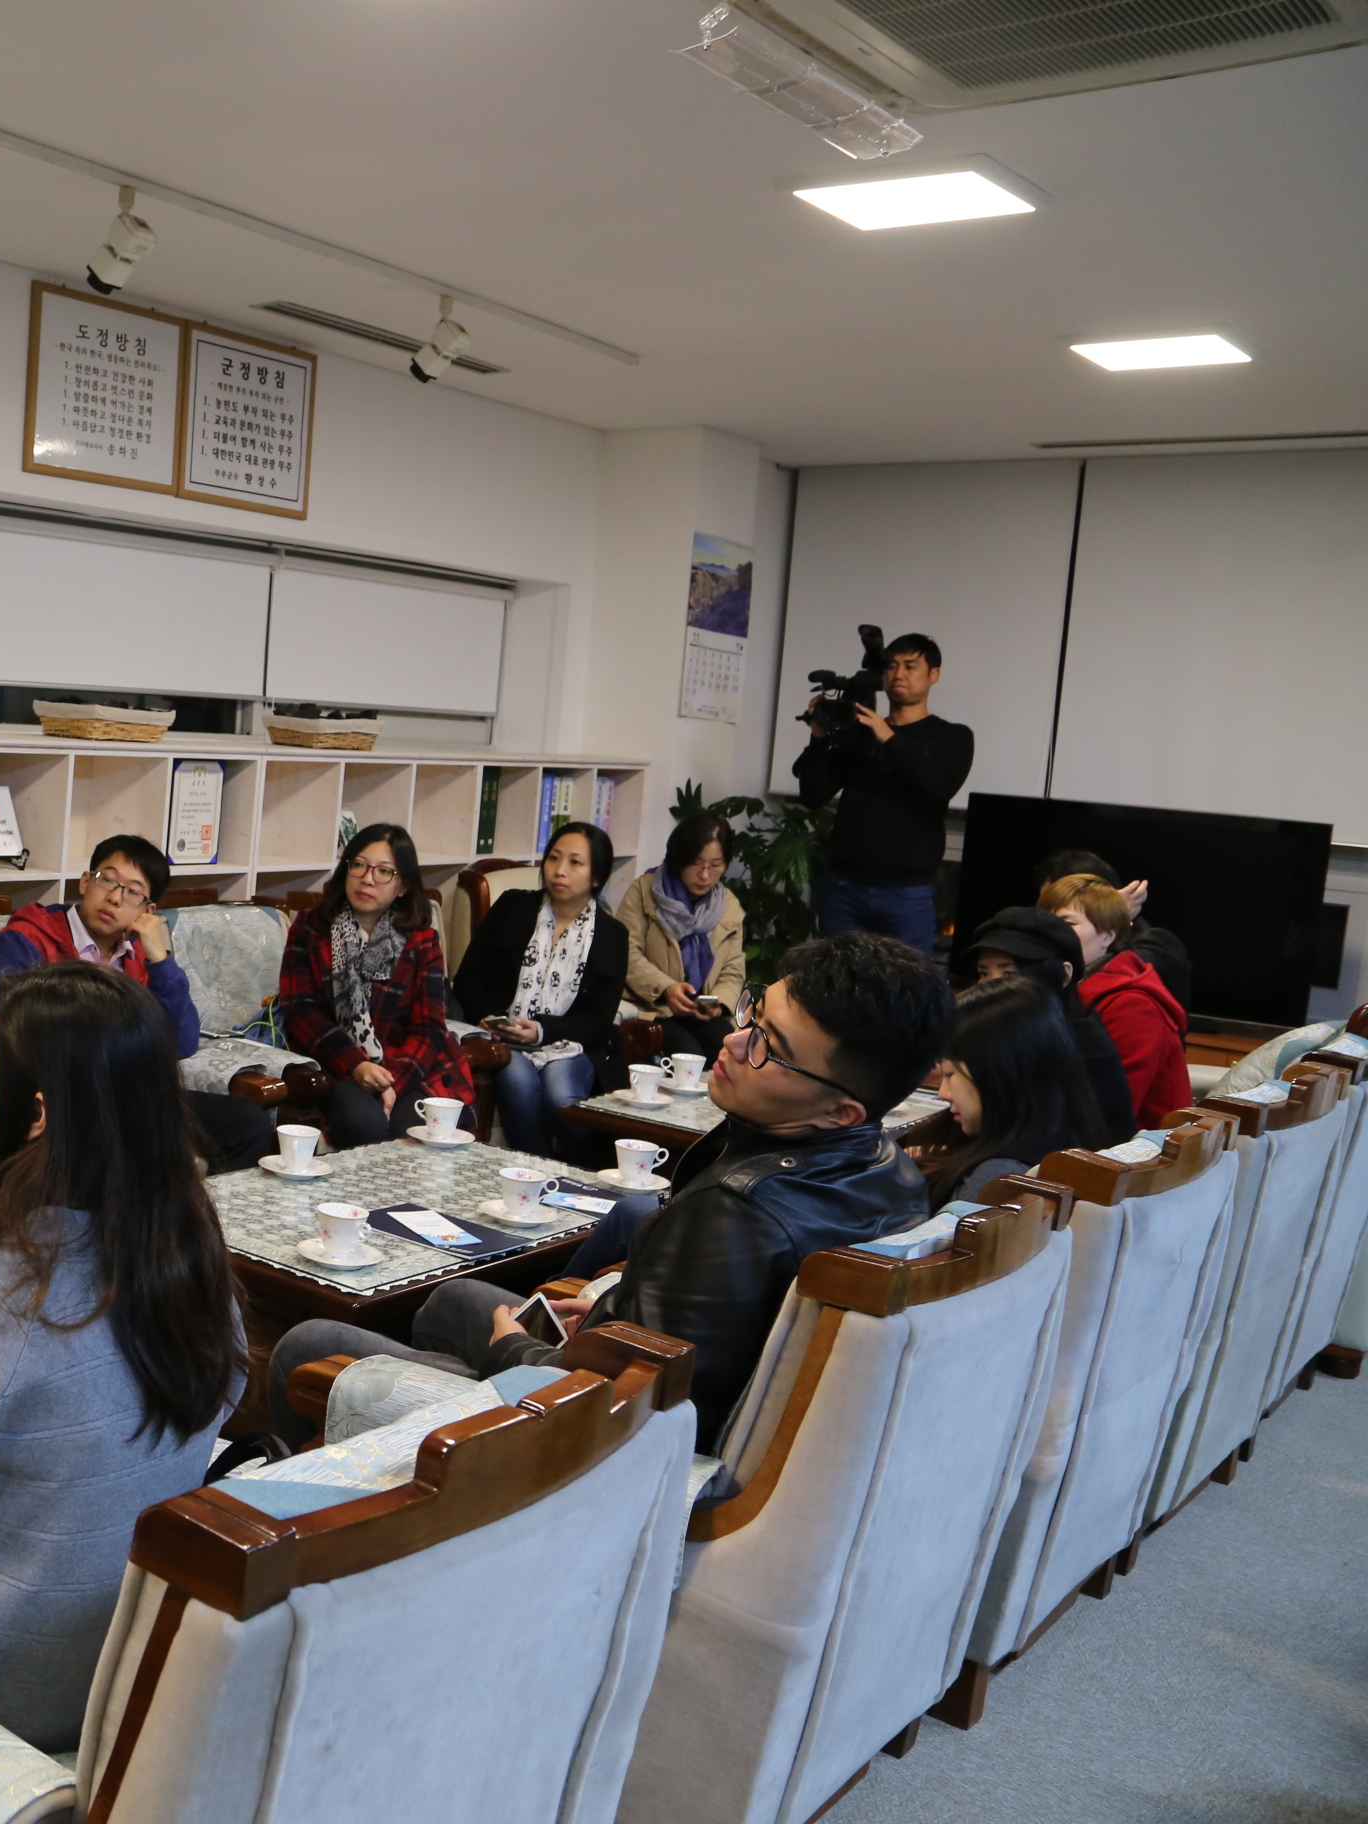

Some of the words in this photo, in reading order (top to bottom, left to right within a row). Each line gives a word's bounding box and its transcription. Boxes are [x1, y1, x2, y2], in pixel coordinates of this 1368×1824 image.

[64, 375, 71, 385] 1.
[75, 377, 107, 392] 창의롭고
[111, 385, 135, 399] 멋스런
[138, 390, 154, 402] 문화
[65, 361, 72, 370] 1.
[75, 363, 108, 378] 안전하고
[113, 371, 136, 385] 건강한
[139, 377, 153, 389] 사회
[62, 403, 70, 413] 1.
[73, 406, 106, 419] 따뜻하고
[110, 413, 134, 426] 정다운
[137, 418, 152, 430] 복지
[63, 389, 70, 399] 1.
[73, 391, 107, 407] 알뜰하게
[110, 399, 134, 412] 커가는
[138, 405, 152, 416] 경제
[204, 395, 210, 407] 1.
[215, 398, 239, 413] 농민도
[243, 404, 258, 417] 부자
[261, 408, 276, 421] 되는
[280, 412, 294, 425] 무주
[62, 418, 69, 427] 1.
[72, 420, 105, 433] 아름답고
[136, 432, 151, 444] 환경
[203, 412, 210, 423] 1.
[214, 414, 237, 430] 교육과
[239, 420, 261, 435] 문화가
[264, 426, 277, 438] 있는
[280, 429, 293, 441] 무주
[202, 429, 209, 440] 1.
[213, 431, 237, 446] 더불어
[241, 437, 256, 450] 함께
[260, 441, 274, 454] 사는
[278, 444, 293, 457] 무주
[201, 445, 208, 456] 1.
[213, 447, 242, 464] 대한민국
[245, 454, 259, 466] 대표
[262, 458, 276, 471] 관광
[278, 460, 293, 473] 무주
